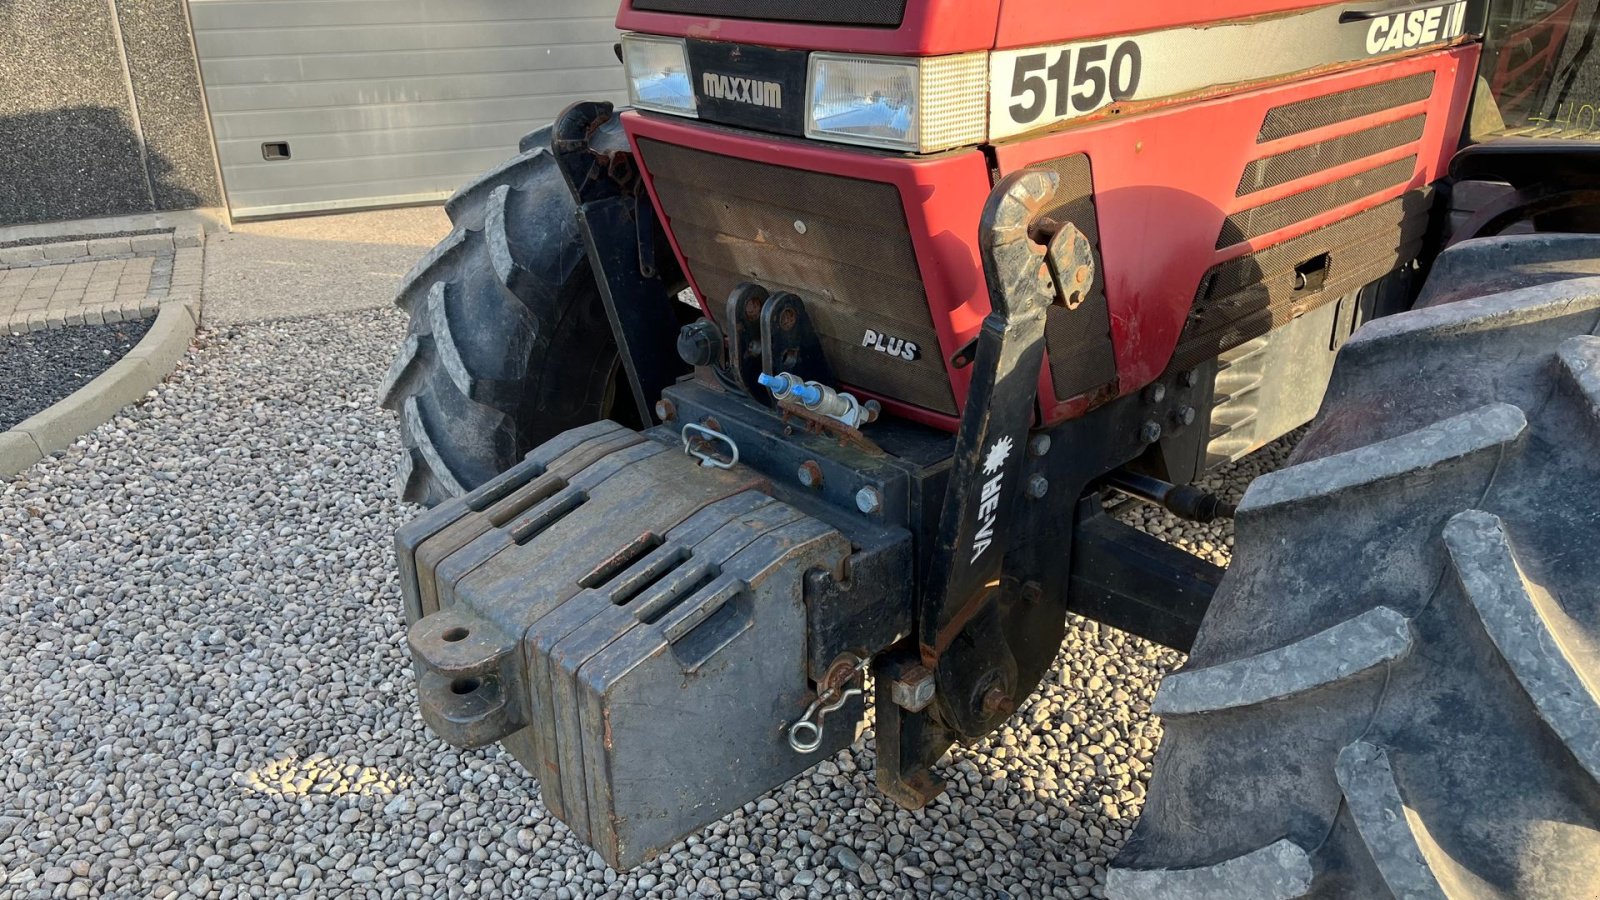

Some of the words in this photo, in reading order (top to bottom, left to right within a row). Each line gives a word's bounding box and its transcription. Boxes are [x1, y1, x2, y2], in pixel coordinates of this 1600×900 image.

[1366, 6, 1443, 54] CASE
[702, 72, 782, 109] MAXXUM
[1008, 40, 1142, 124] 5150
[862, 329, 917, 361] PLUS
